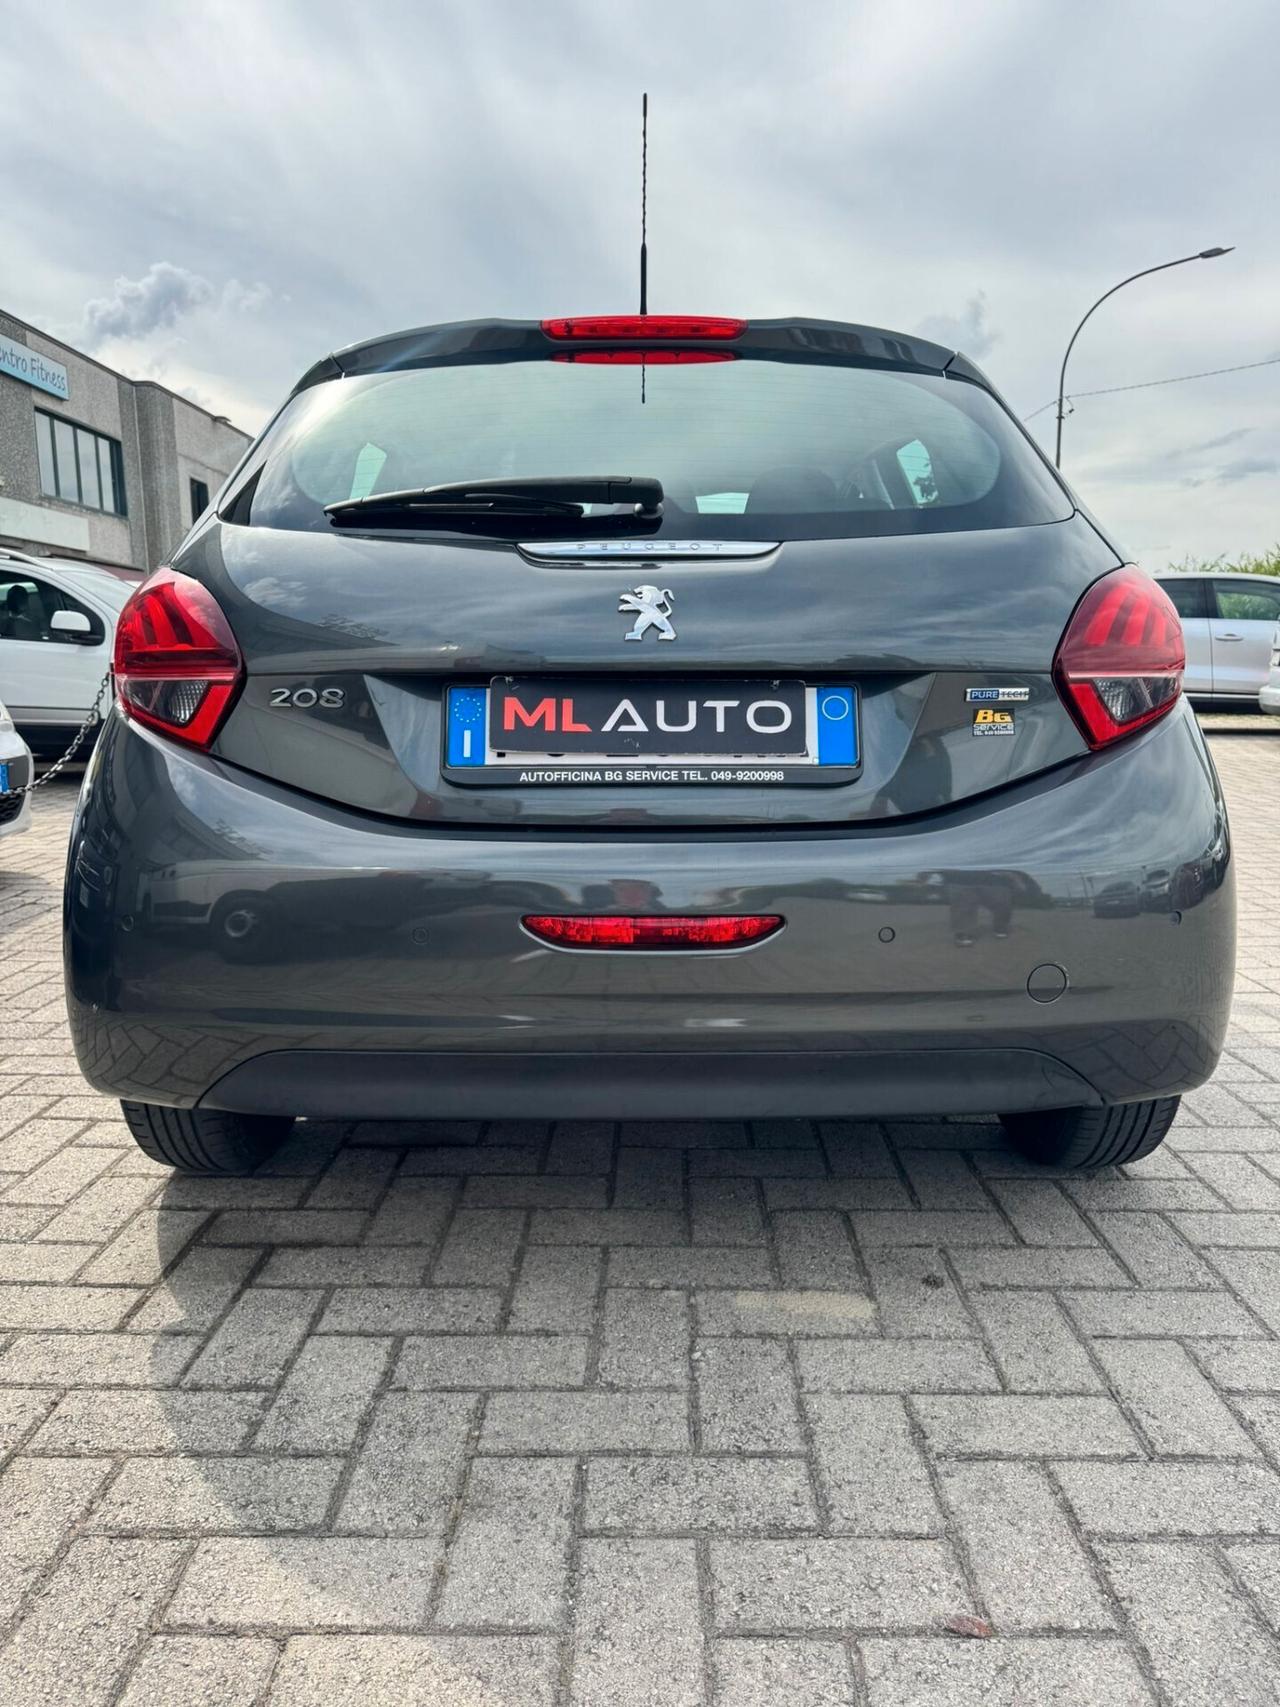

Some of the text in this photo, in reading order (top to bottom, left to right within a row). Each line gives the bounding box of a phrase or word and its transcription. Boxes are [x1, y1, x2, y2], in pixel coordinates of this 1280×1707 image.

[31, 358, 65, 391] Fitness
[576, 542, 722, 552] PEUGEOT
[269, 687, 345, 709] 208
[503, 696, 793, 733] ML AUTO
[975, 709, 1013, 723] BG
[519, 770, 785, 782] AUTOFFICINA BG SERVICE TEL. 049-9200998
